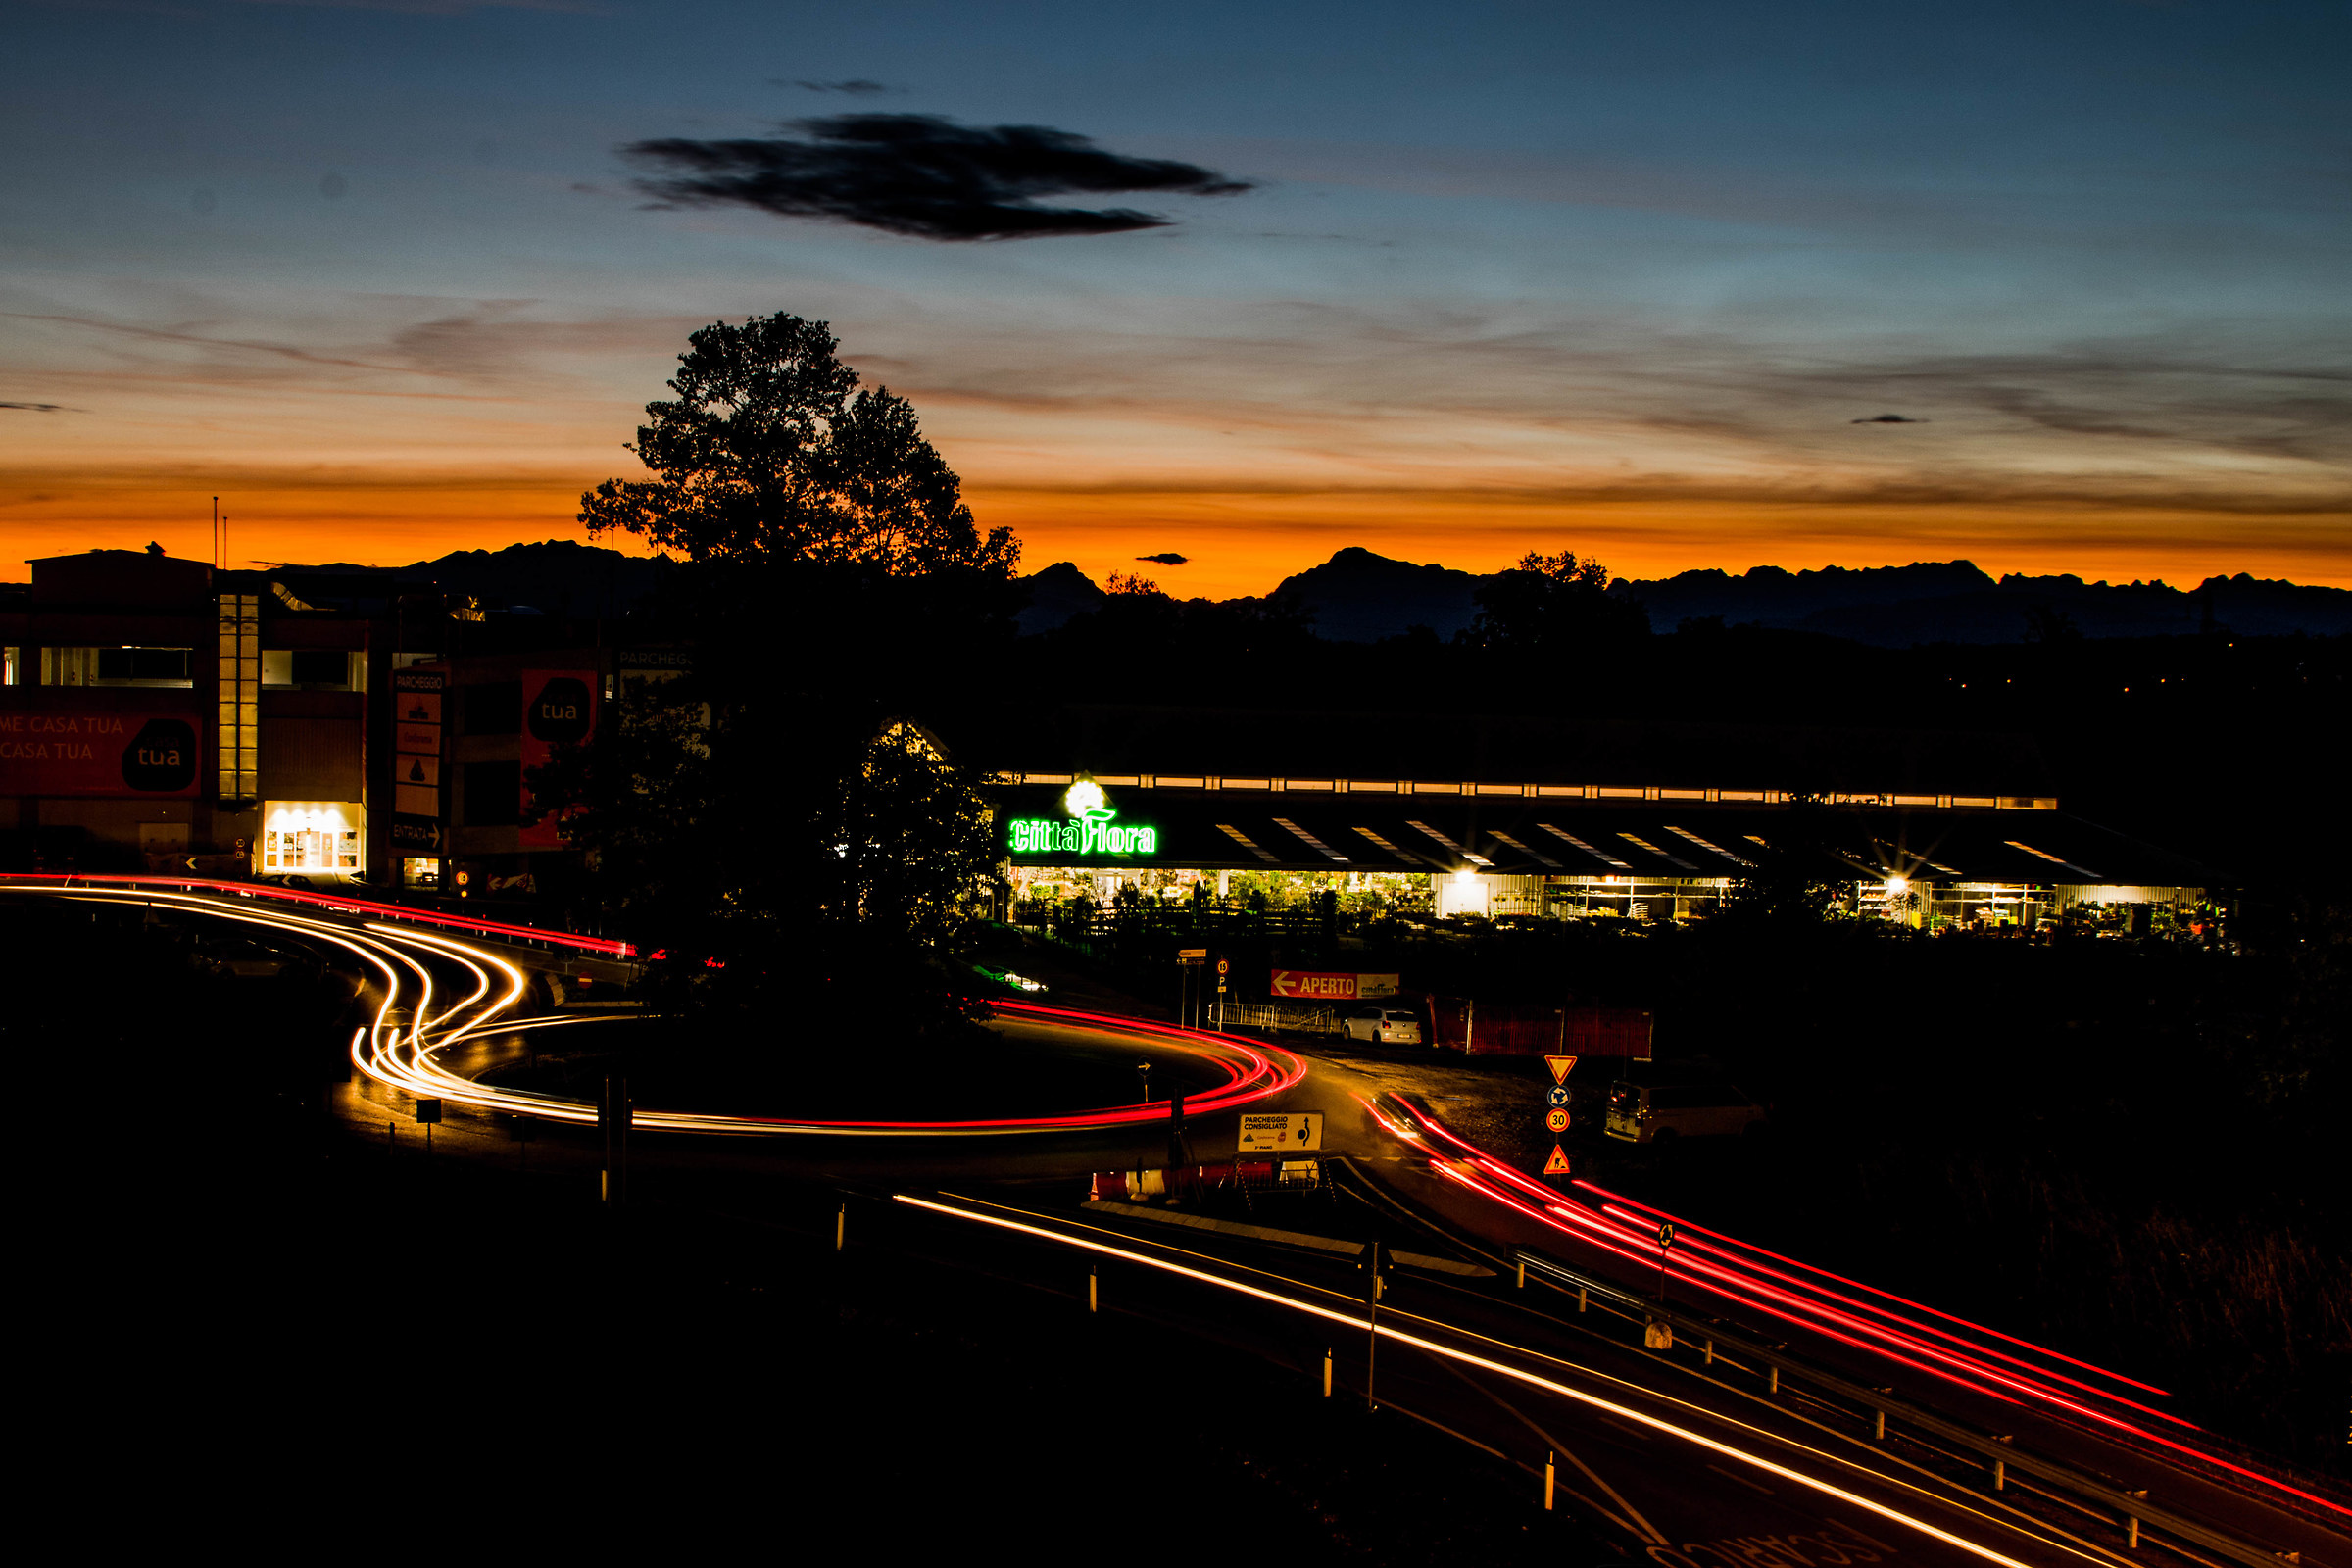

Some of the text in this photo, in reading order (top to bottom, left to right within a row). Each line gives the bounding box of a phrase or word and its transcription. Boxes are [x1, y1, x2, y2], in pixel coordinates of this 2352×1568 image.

[619, 651, 694, 665] PARCHEG
[396, 674, 443, 690] PARCHEGGIO
[541, 703, 578, 720] tua
[29, 716, 79, 733] CASA
[84, 717, 124, 734] TUA
[0, 742, 94, 760] CASA TUA
[137, 746, 181, 766] tua
[1300, 976, 1355, 995] APERTO
[1552, 1114, 1565, 1126] 30
